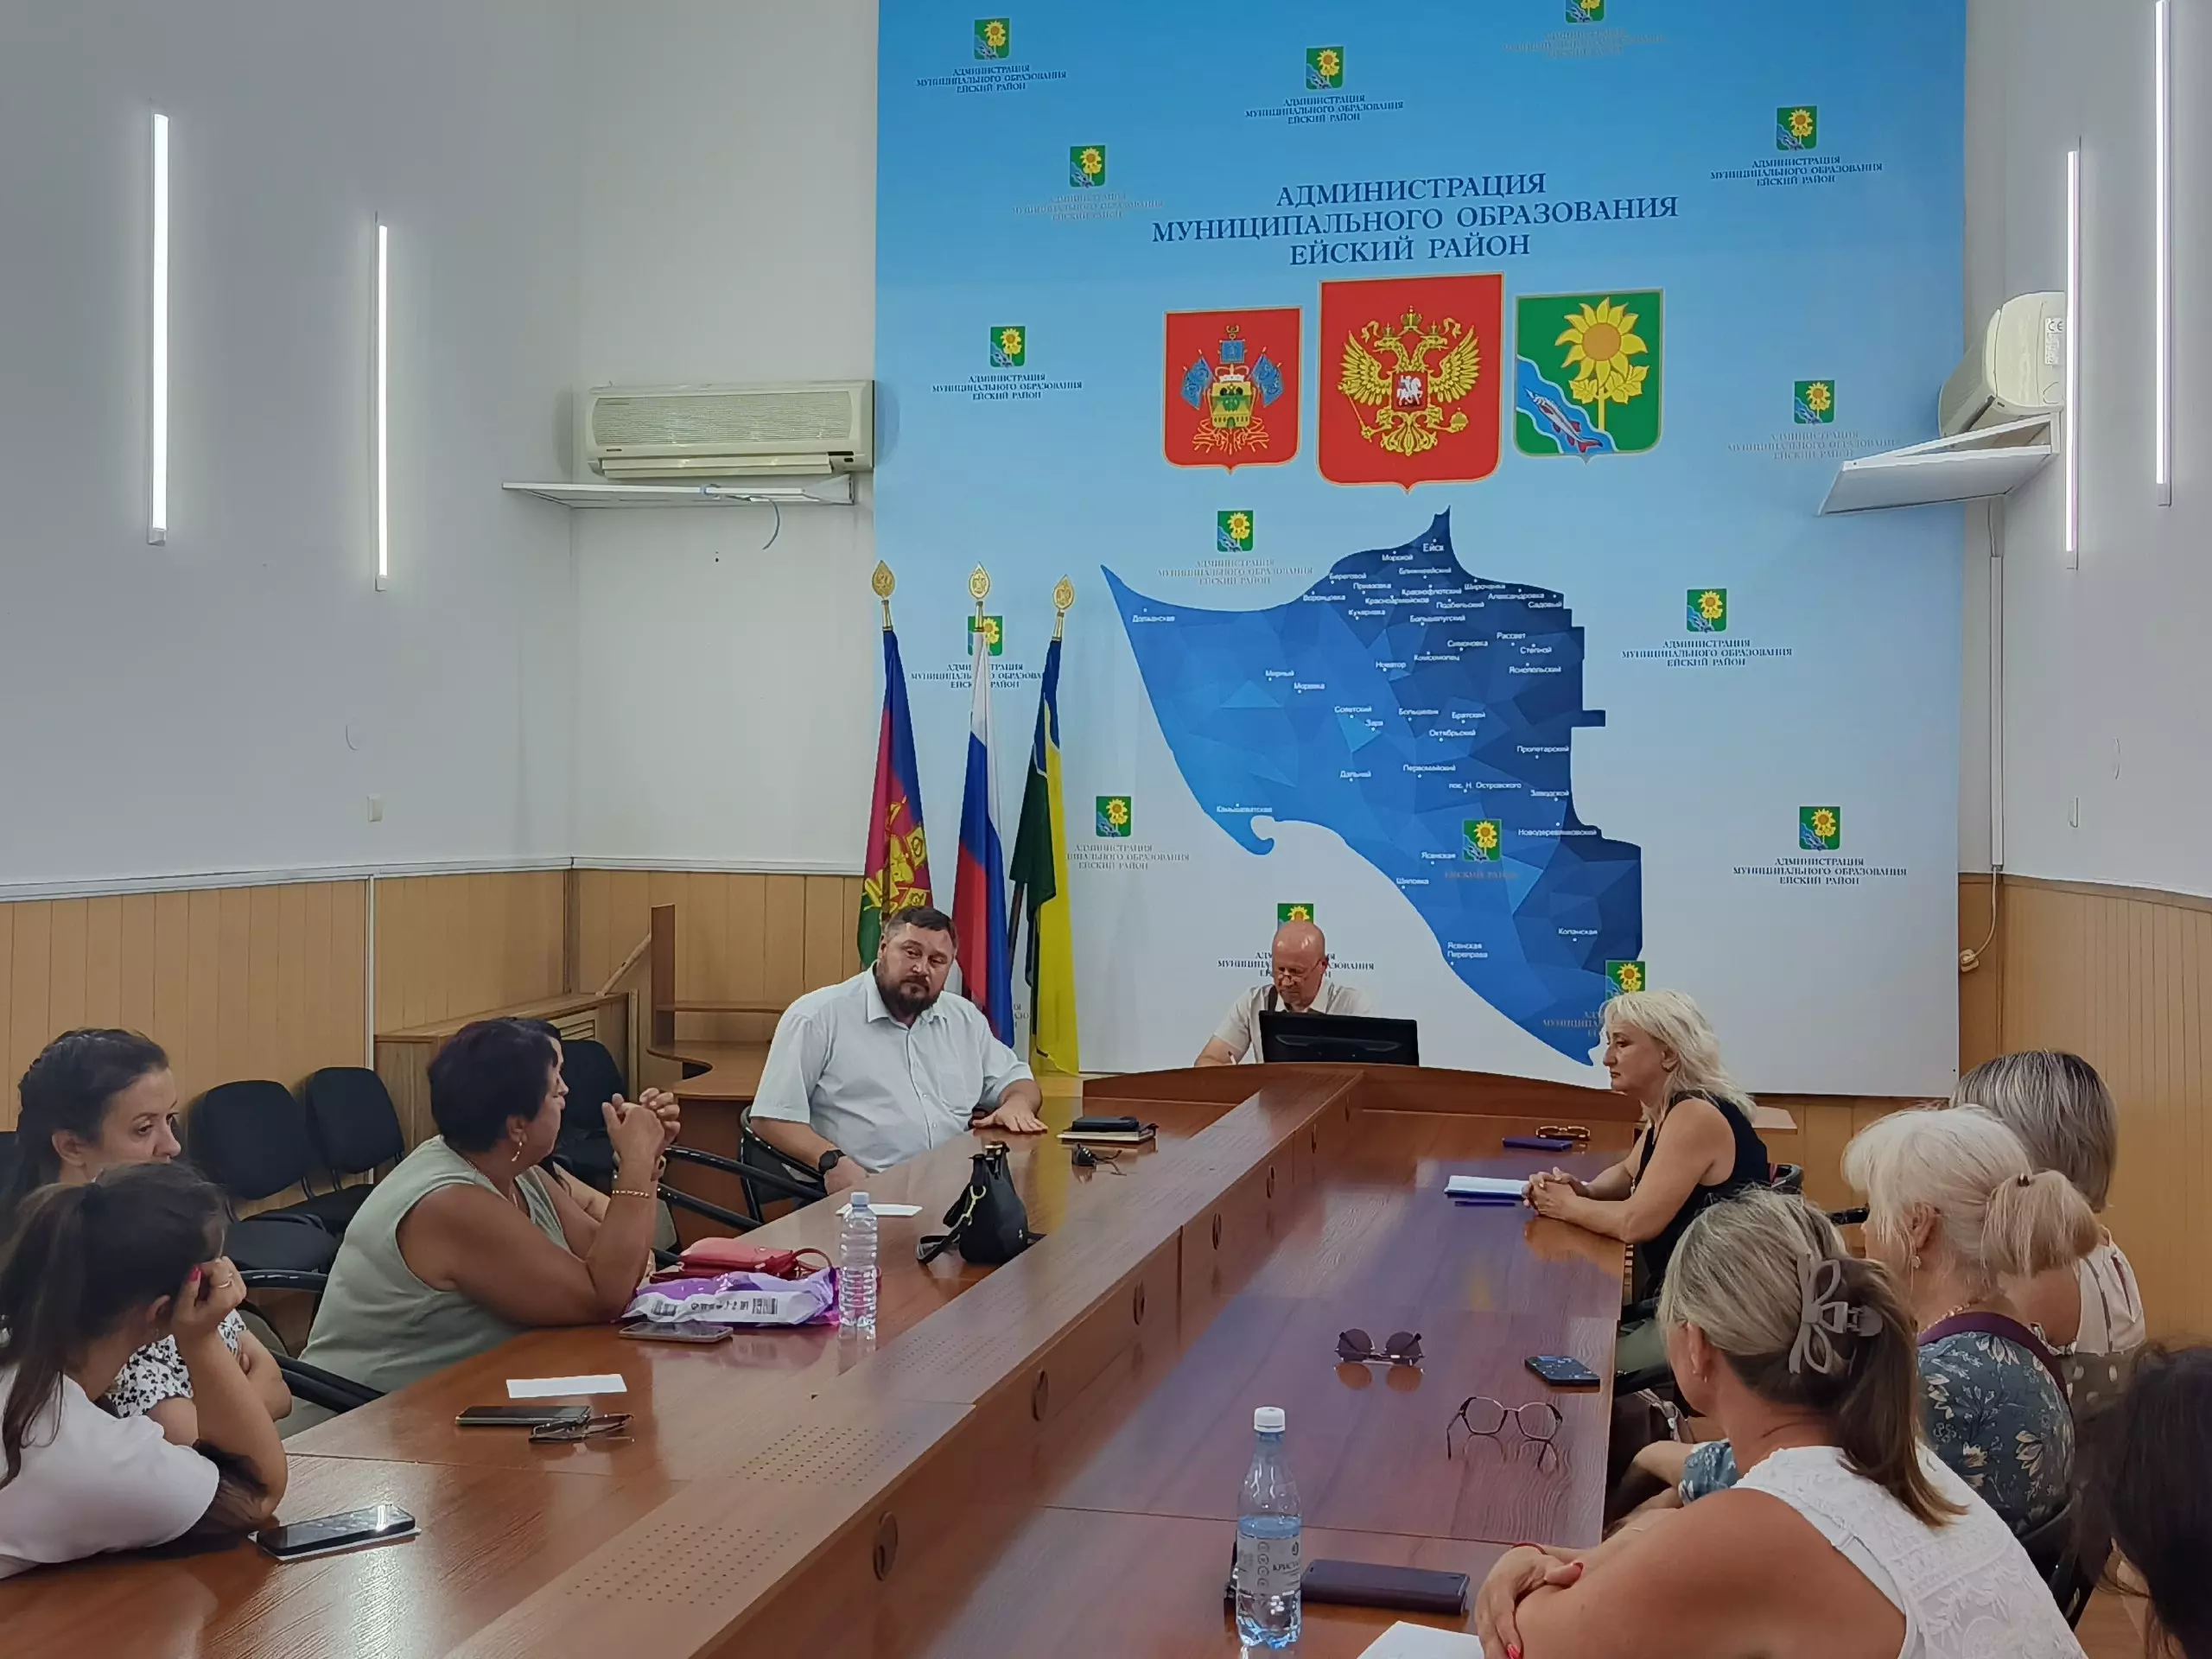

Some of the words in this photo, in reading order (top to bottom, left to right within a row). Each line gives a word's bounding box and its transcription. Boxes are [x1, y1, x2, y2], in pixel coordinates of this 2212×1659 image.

[1276, 173, 1546, 208] АДМИНИСТРАЦИЯ
[1152, 209, 1443, 242] МУНИЦИПАЛЬНОГО
[1457, 197, 1679, 227] ОБРАЗОВАНИЯ
[1290, 235, 1414, 265] ЕЙСКИЙ
[1428, 232, 1530, 258] РАЙОН
[1423, 543, 1444, 552] Ейск
[1662, 639, 1751, 649] АДМИНИСТРАЦИЯ
[1622, 650, 1718, 658] МУНИЦИПАЛЬНОГО
[1667, 658, 1708, 667] ЕЙСКИЙ
[1713, 658, 1745, 666] РАЙОН
[1775, 857, 1864, 866] АДМИНИСТРАЦИЯ
[1732, 867, 1831, 875] МУНИЦИПАЛЬНОГО
[1780, 876, 1821, 885] ЕЙСКИЙ
